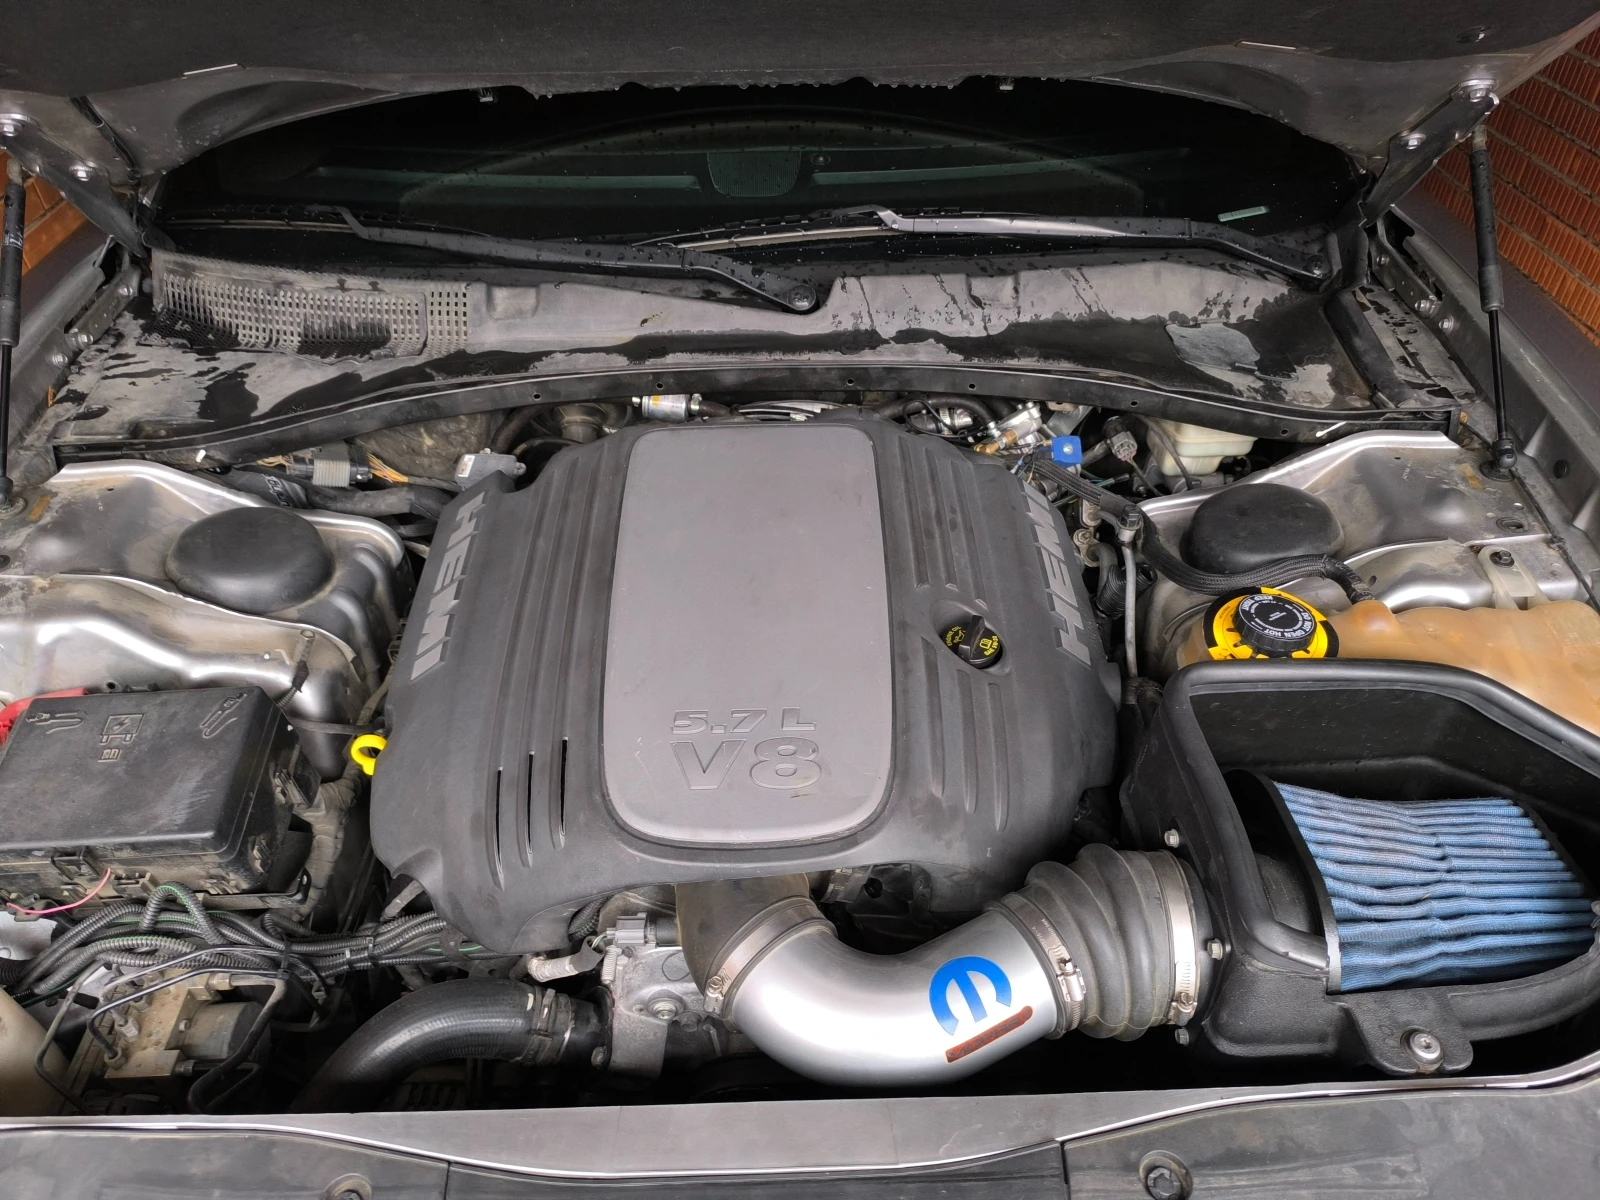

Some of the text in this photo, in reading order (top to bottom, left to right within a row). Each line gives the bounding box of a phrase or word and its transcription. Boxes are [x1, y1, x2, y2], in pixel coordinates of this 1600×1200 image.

[411, 491, 485, 680] HEMI
[1023, 480, 1091, 666] HEMI
[1263, 628, 1282, 637] HOT
[1283, 630, 1305, 638] OPEN
[669, 736, 822, 790] V8
